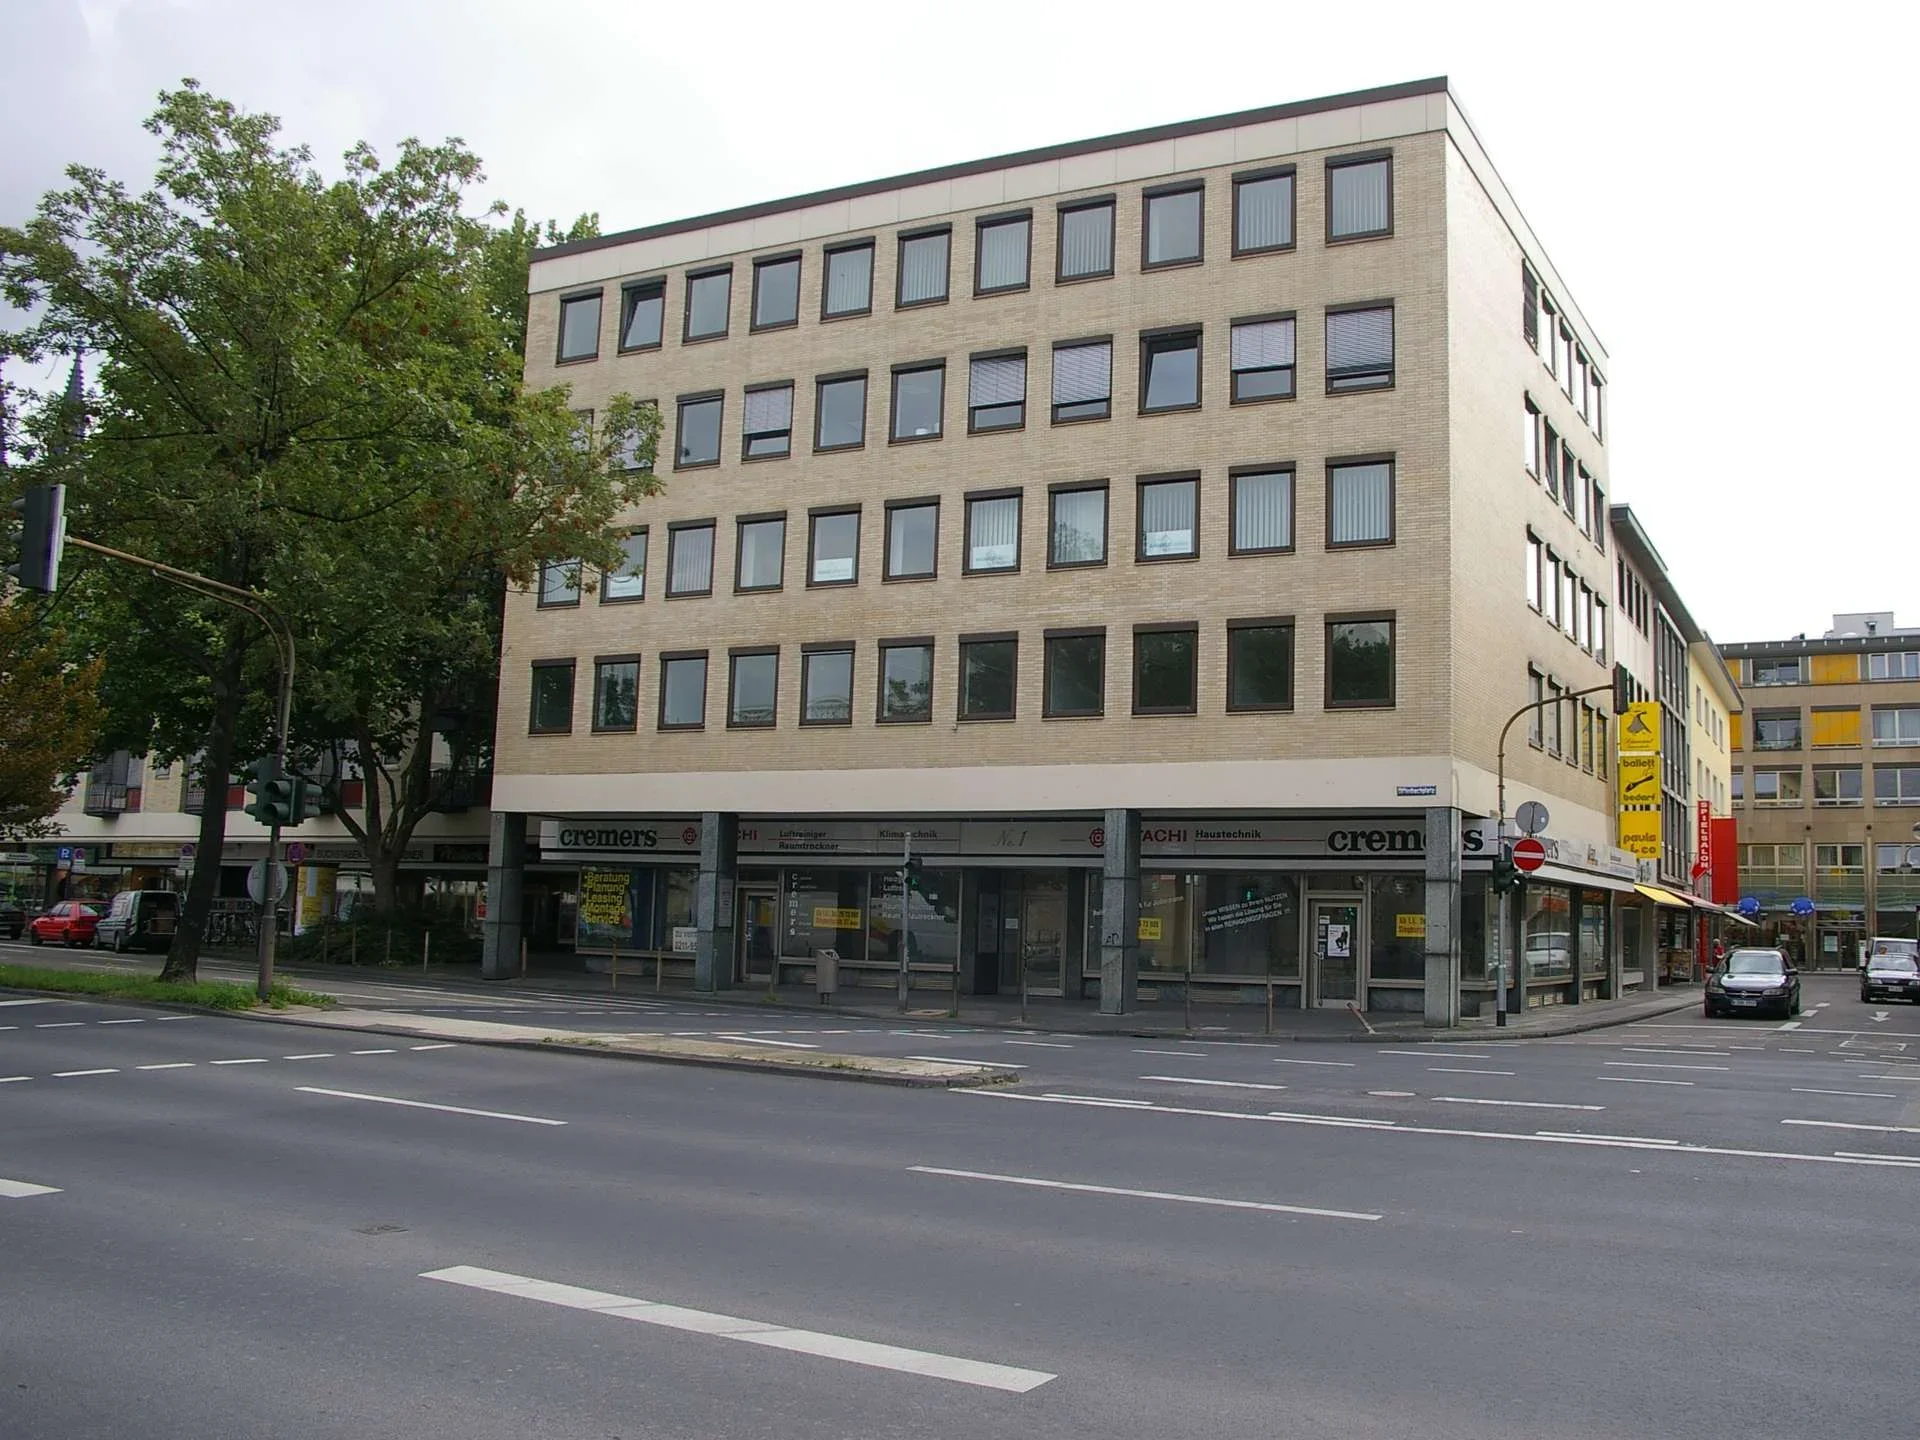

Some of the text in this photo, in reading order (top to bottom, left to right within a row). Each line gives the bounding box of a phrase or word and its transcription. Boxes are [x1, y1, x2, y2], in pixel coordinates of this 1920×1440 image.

[560, 828, 657, 847] cremers
[1195, 829, 1262, 839] Haustechnik
[1328, 829, 1484, 852] crems
[1700, 802, 1709, 869] SPIELSALON
